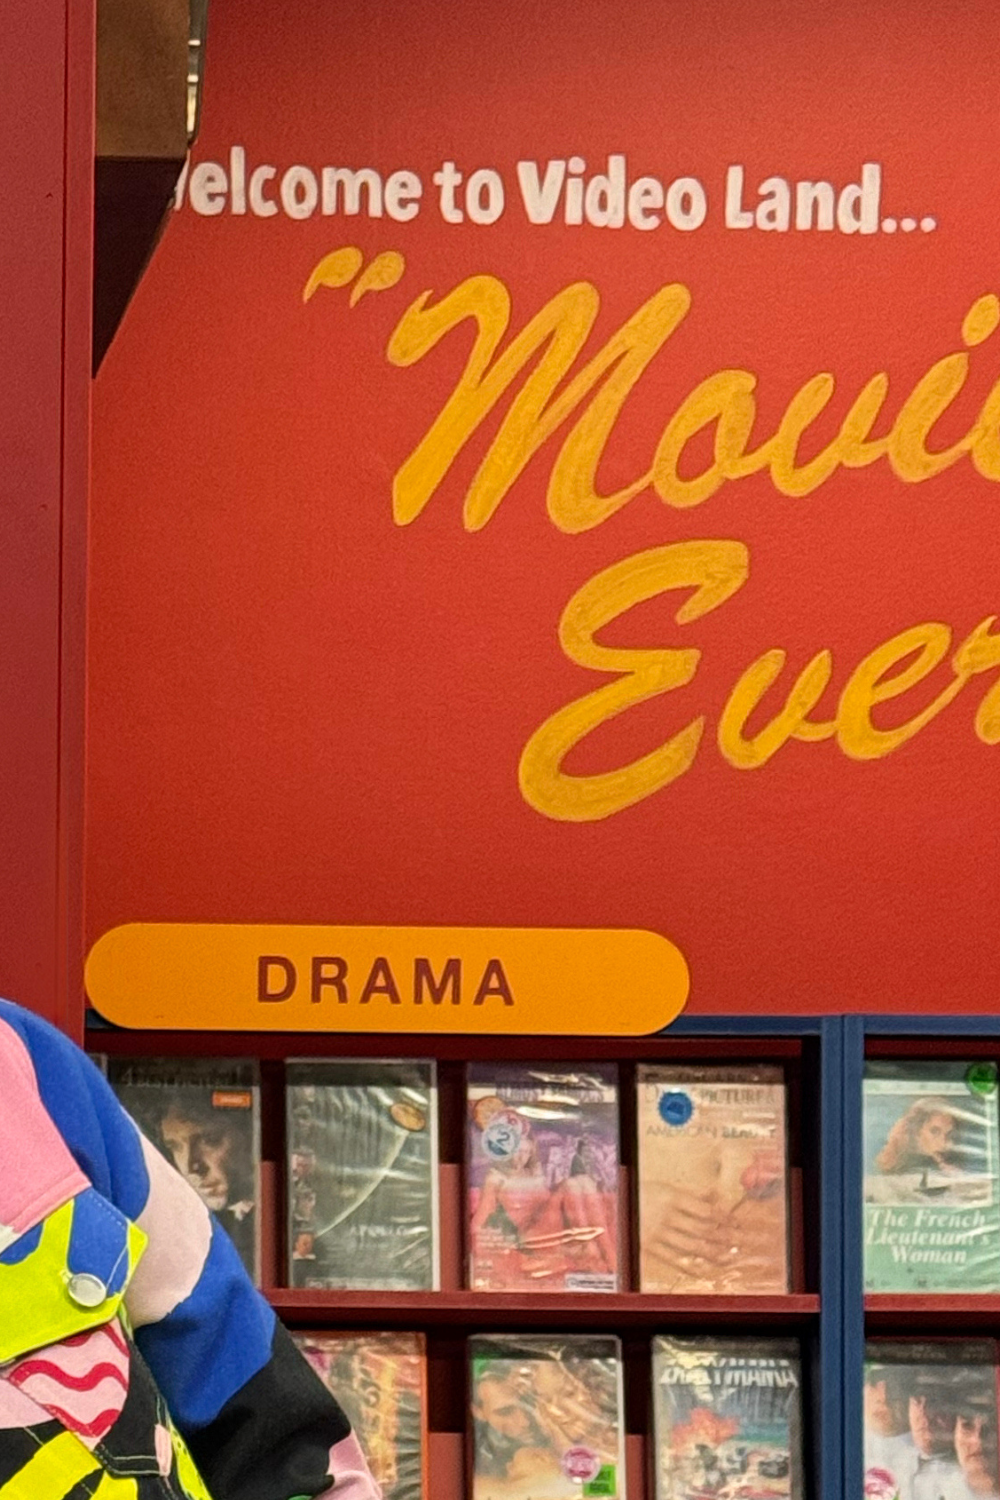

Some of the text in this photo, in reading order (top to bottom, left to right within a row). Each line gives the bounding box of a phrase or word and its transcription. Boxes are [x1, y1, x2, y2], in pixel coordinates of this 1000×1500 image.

[174, 146, 937, 235] elcome to Video Land...
[257, 955, 515, 1006] DRAMA
[870, 1208, 986, 1228] The French
[891, 1245, 968, 1265] Woman
